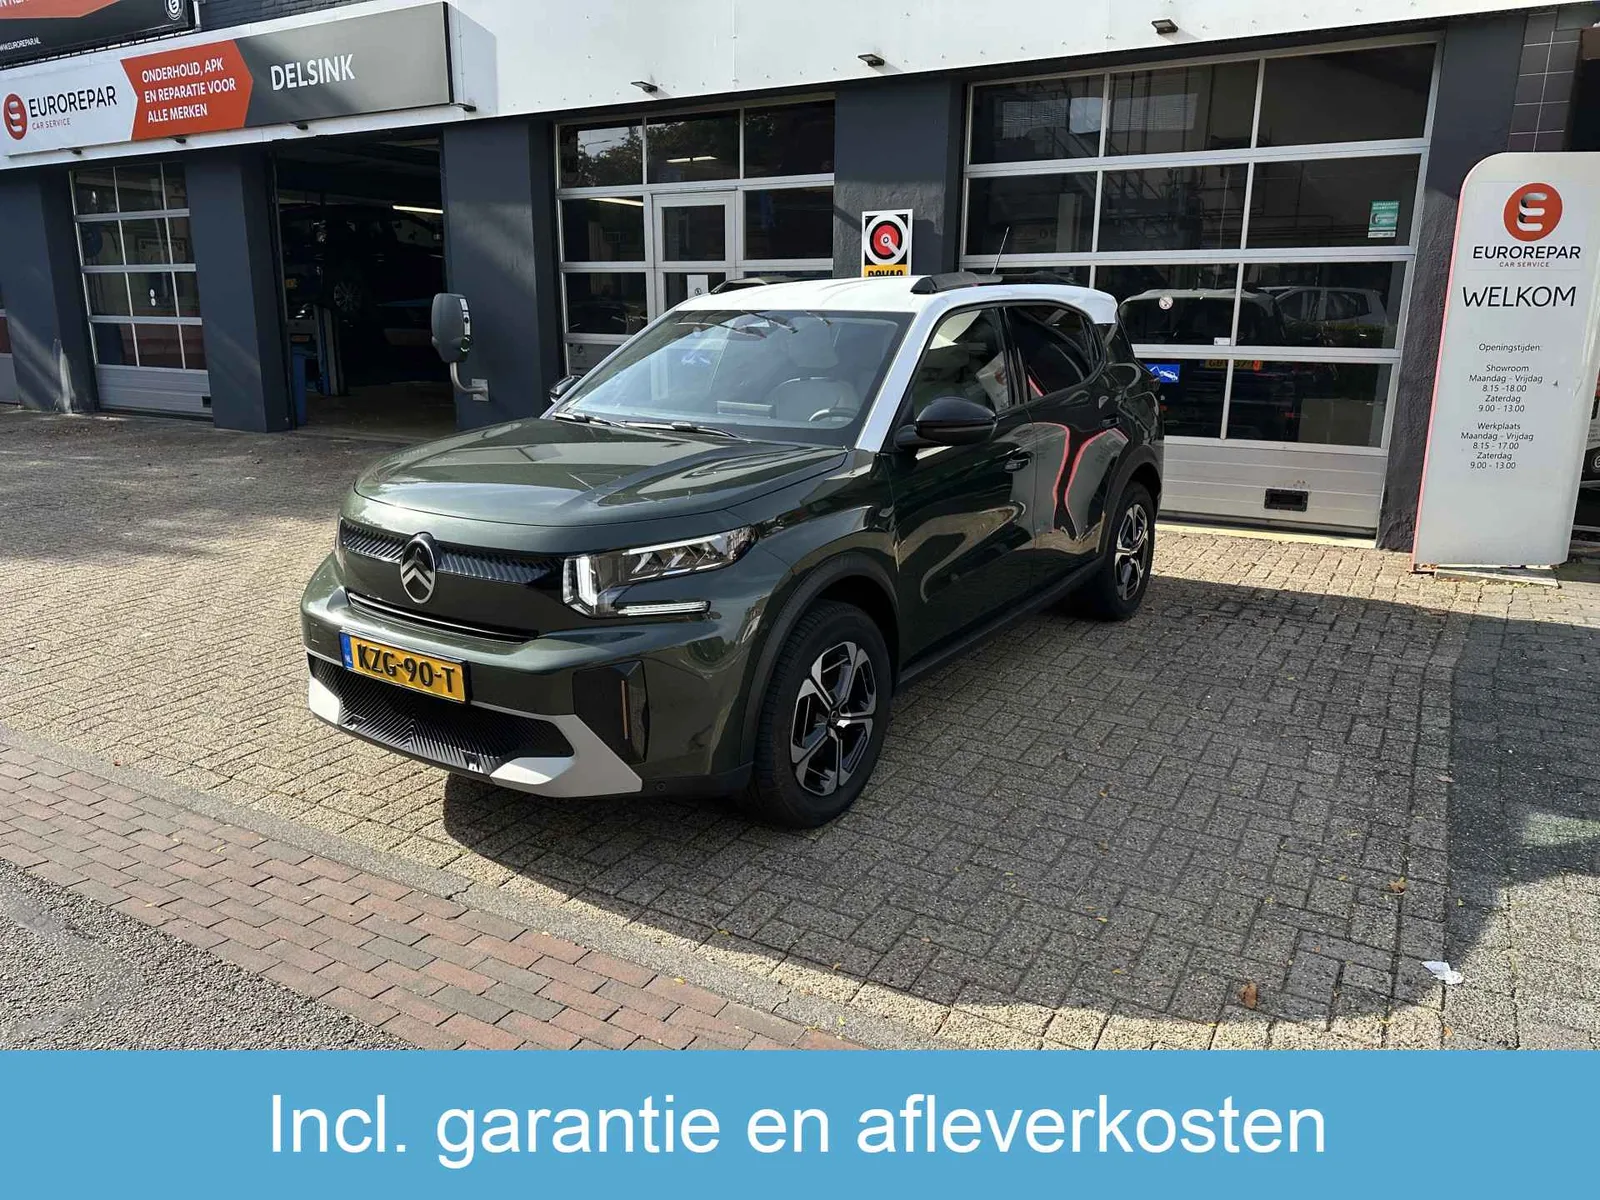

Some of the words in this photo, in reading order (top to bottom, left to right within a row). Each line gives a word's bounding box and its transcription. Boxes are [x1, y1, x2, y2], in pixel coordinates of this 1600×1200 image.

[142, 61, 203, 83] ONDERHOUD,
[204, 57, 224, 74] APK
[270, 53, 355, 91] DELSINK
[144, 89, 157, 103] EN
[158, 81, 207, 102] REPARATIE
[207, 77, 236, 94] VOOR
[28, 85, 117, 118] EUROREPAR
[147, 107, 169, 123] ALLE
[170, 103, 208, 120] MERKEN
[32, 121, 44, 130] CAR
[45, 118, 71, 129] SERVICE
[1472, 246, 1581, 259] EUROREPAR
[1462, 286, 1577, 307] WELKOM
[1486, 364, 1530, 372] Showroom
[1469, 374, 1507, 384] Maandag
[1514, 374, 1543, 384] Vrijdag
[1485, 394, 1521, 404] Zaterdag
[1477, 422, 1521, 431] Werkplaats
[1460, 432, 1498, 441] Maandag
[1506, 432, 1534, 441] Vrijdag
[1476, 452, 1513, 461] Zaterdag
[356, 643, 455, 693] KZG-90-T
